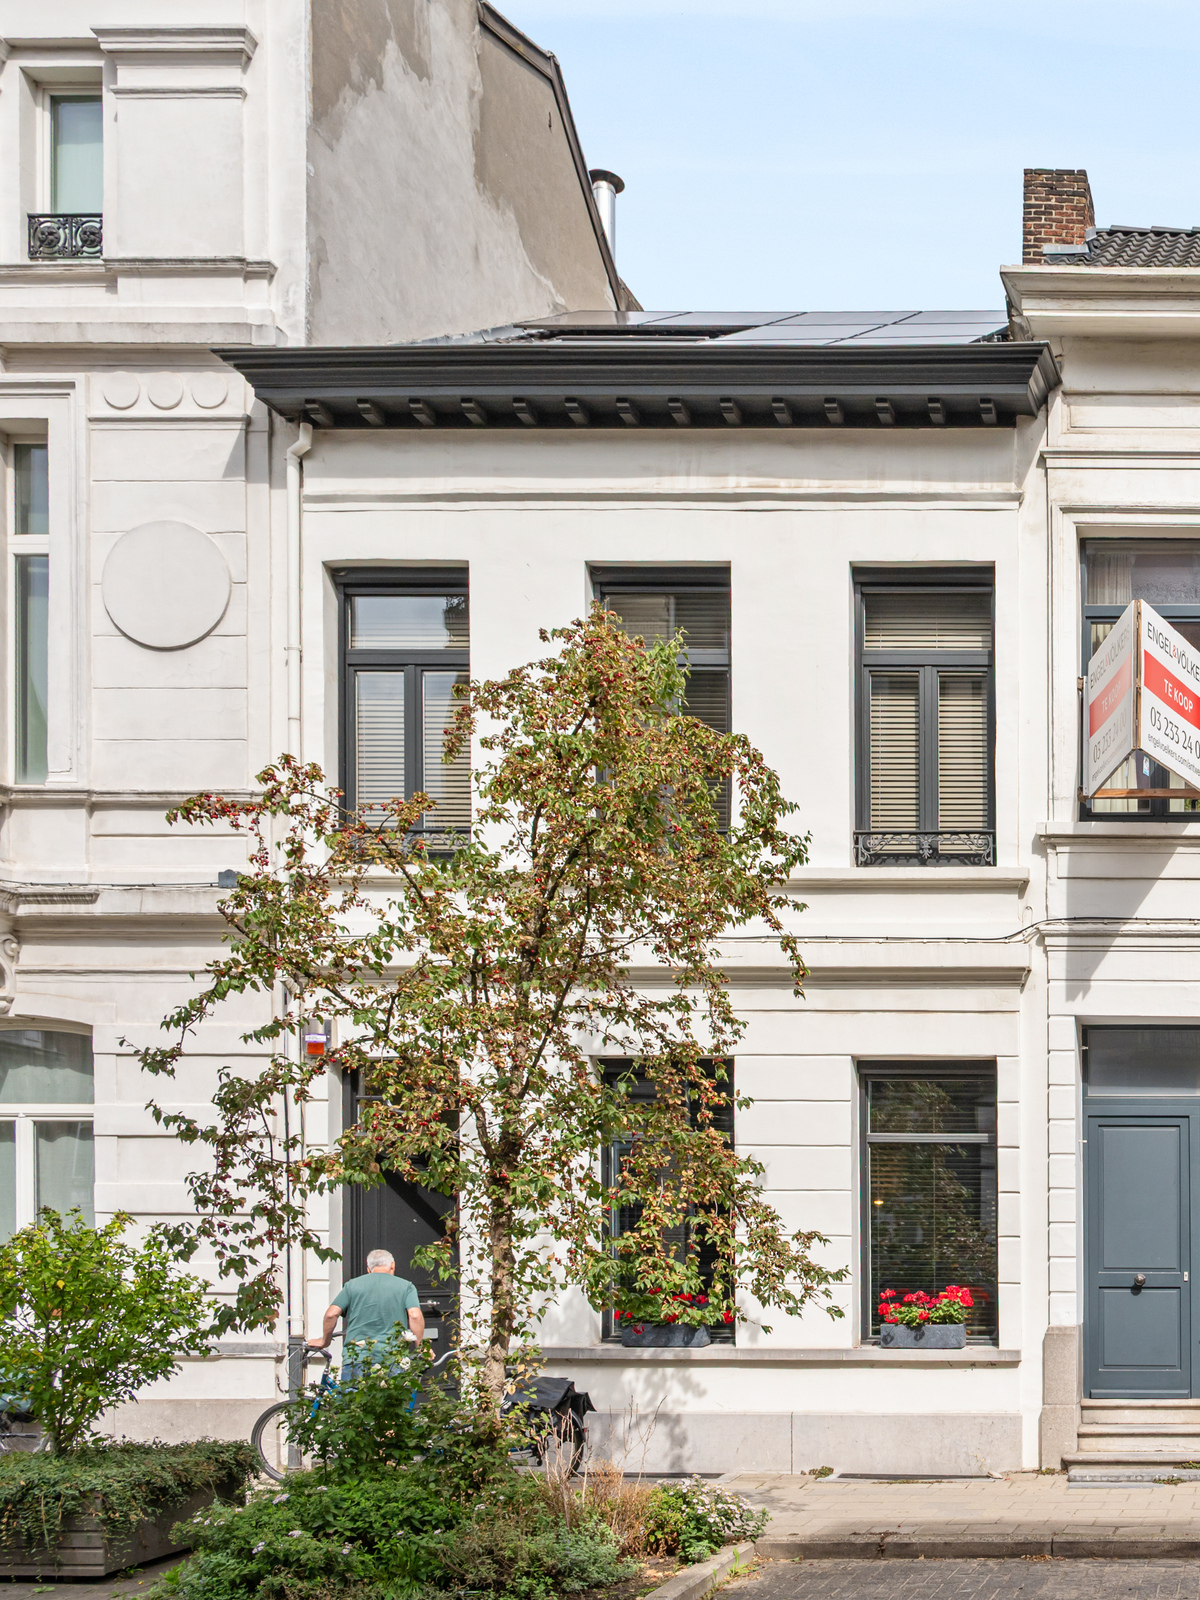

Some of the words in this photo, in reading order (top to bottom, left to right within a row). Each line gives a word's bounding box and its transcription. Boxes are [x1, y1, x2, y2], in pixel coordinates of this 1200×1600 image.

[1163, 678, 1173, 698] TE
[1173, 687, 1194, 713] KOOP
[1150, 706, 1162, 731] 03
[1163, 716, 1180, 744] 233
[1182, 730, 1193, 754] 24
